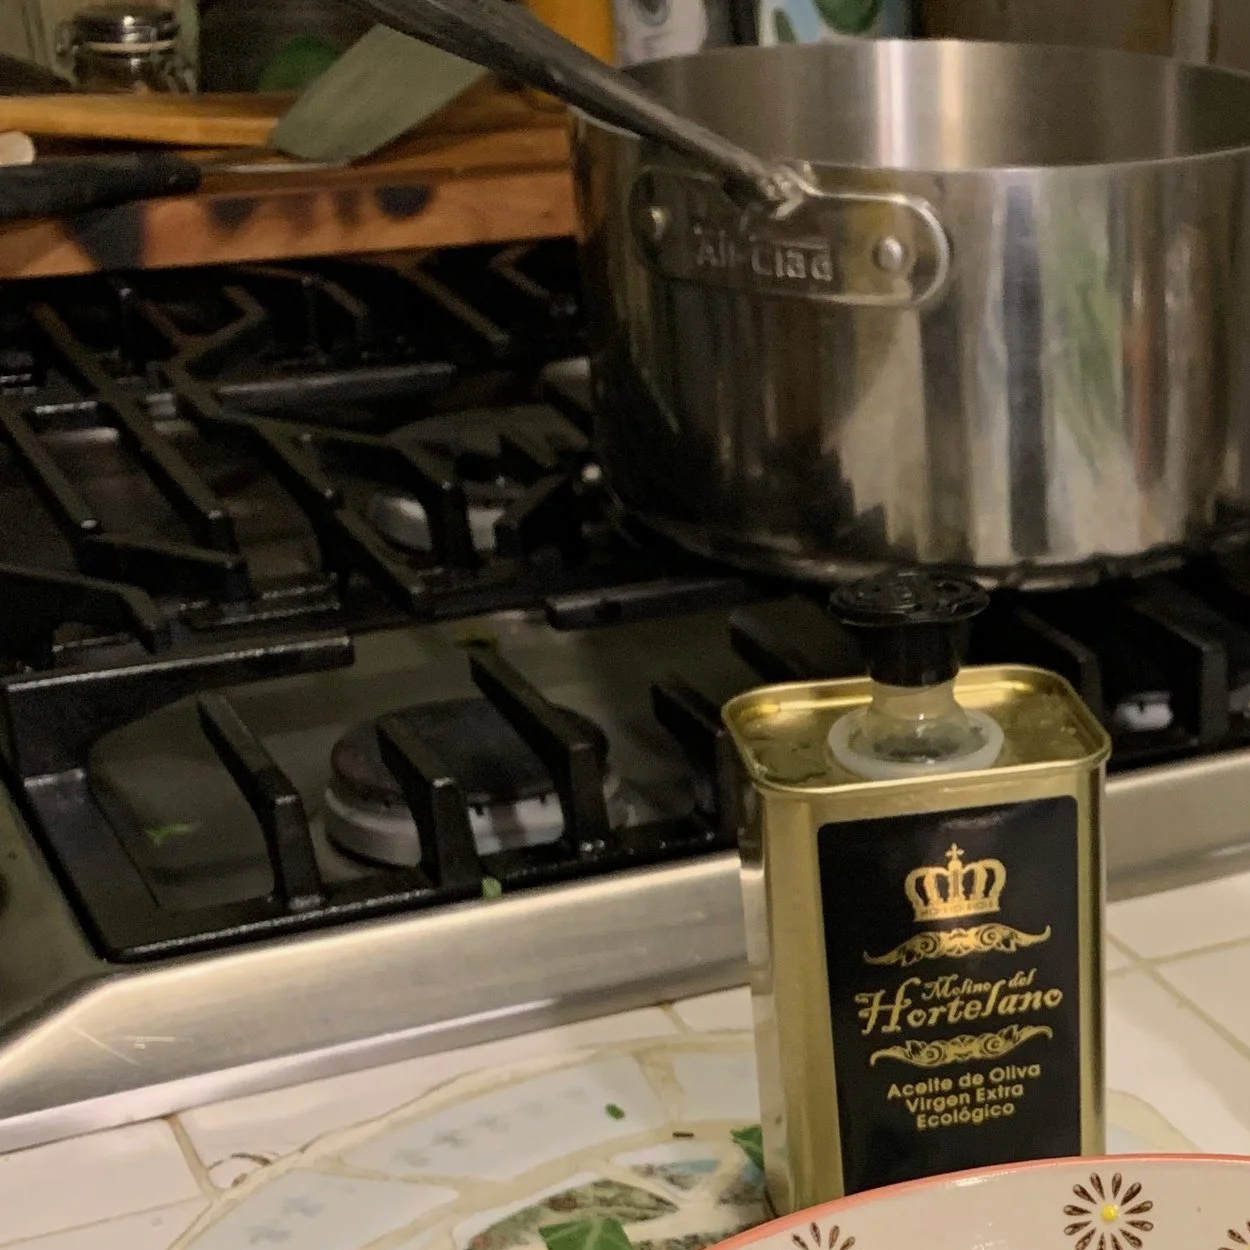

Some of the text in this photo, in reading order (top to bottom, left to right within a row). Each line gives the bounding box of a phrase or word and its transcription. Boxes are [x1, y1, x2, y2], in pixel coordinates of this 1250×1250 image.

[921, 967, 1038, 1001] Molino del
[854, 976, 1064, 1036] Hortelano
[886, 1063, 1042, 1100] Aceite de Oliva
[905, 1082, 1024, 1114] Virgen Extra
[916, 1101, 1016, 1130] Ecológico
